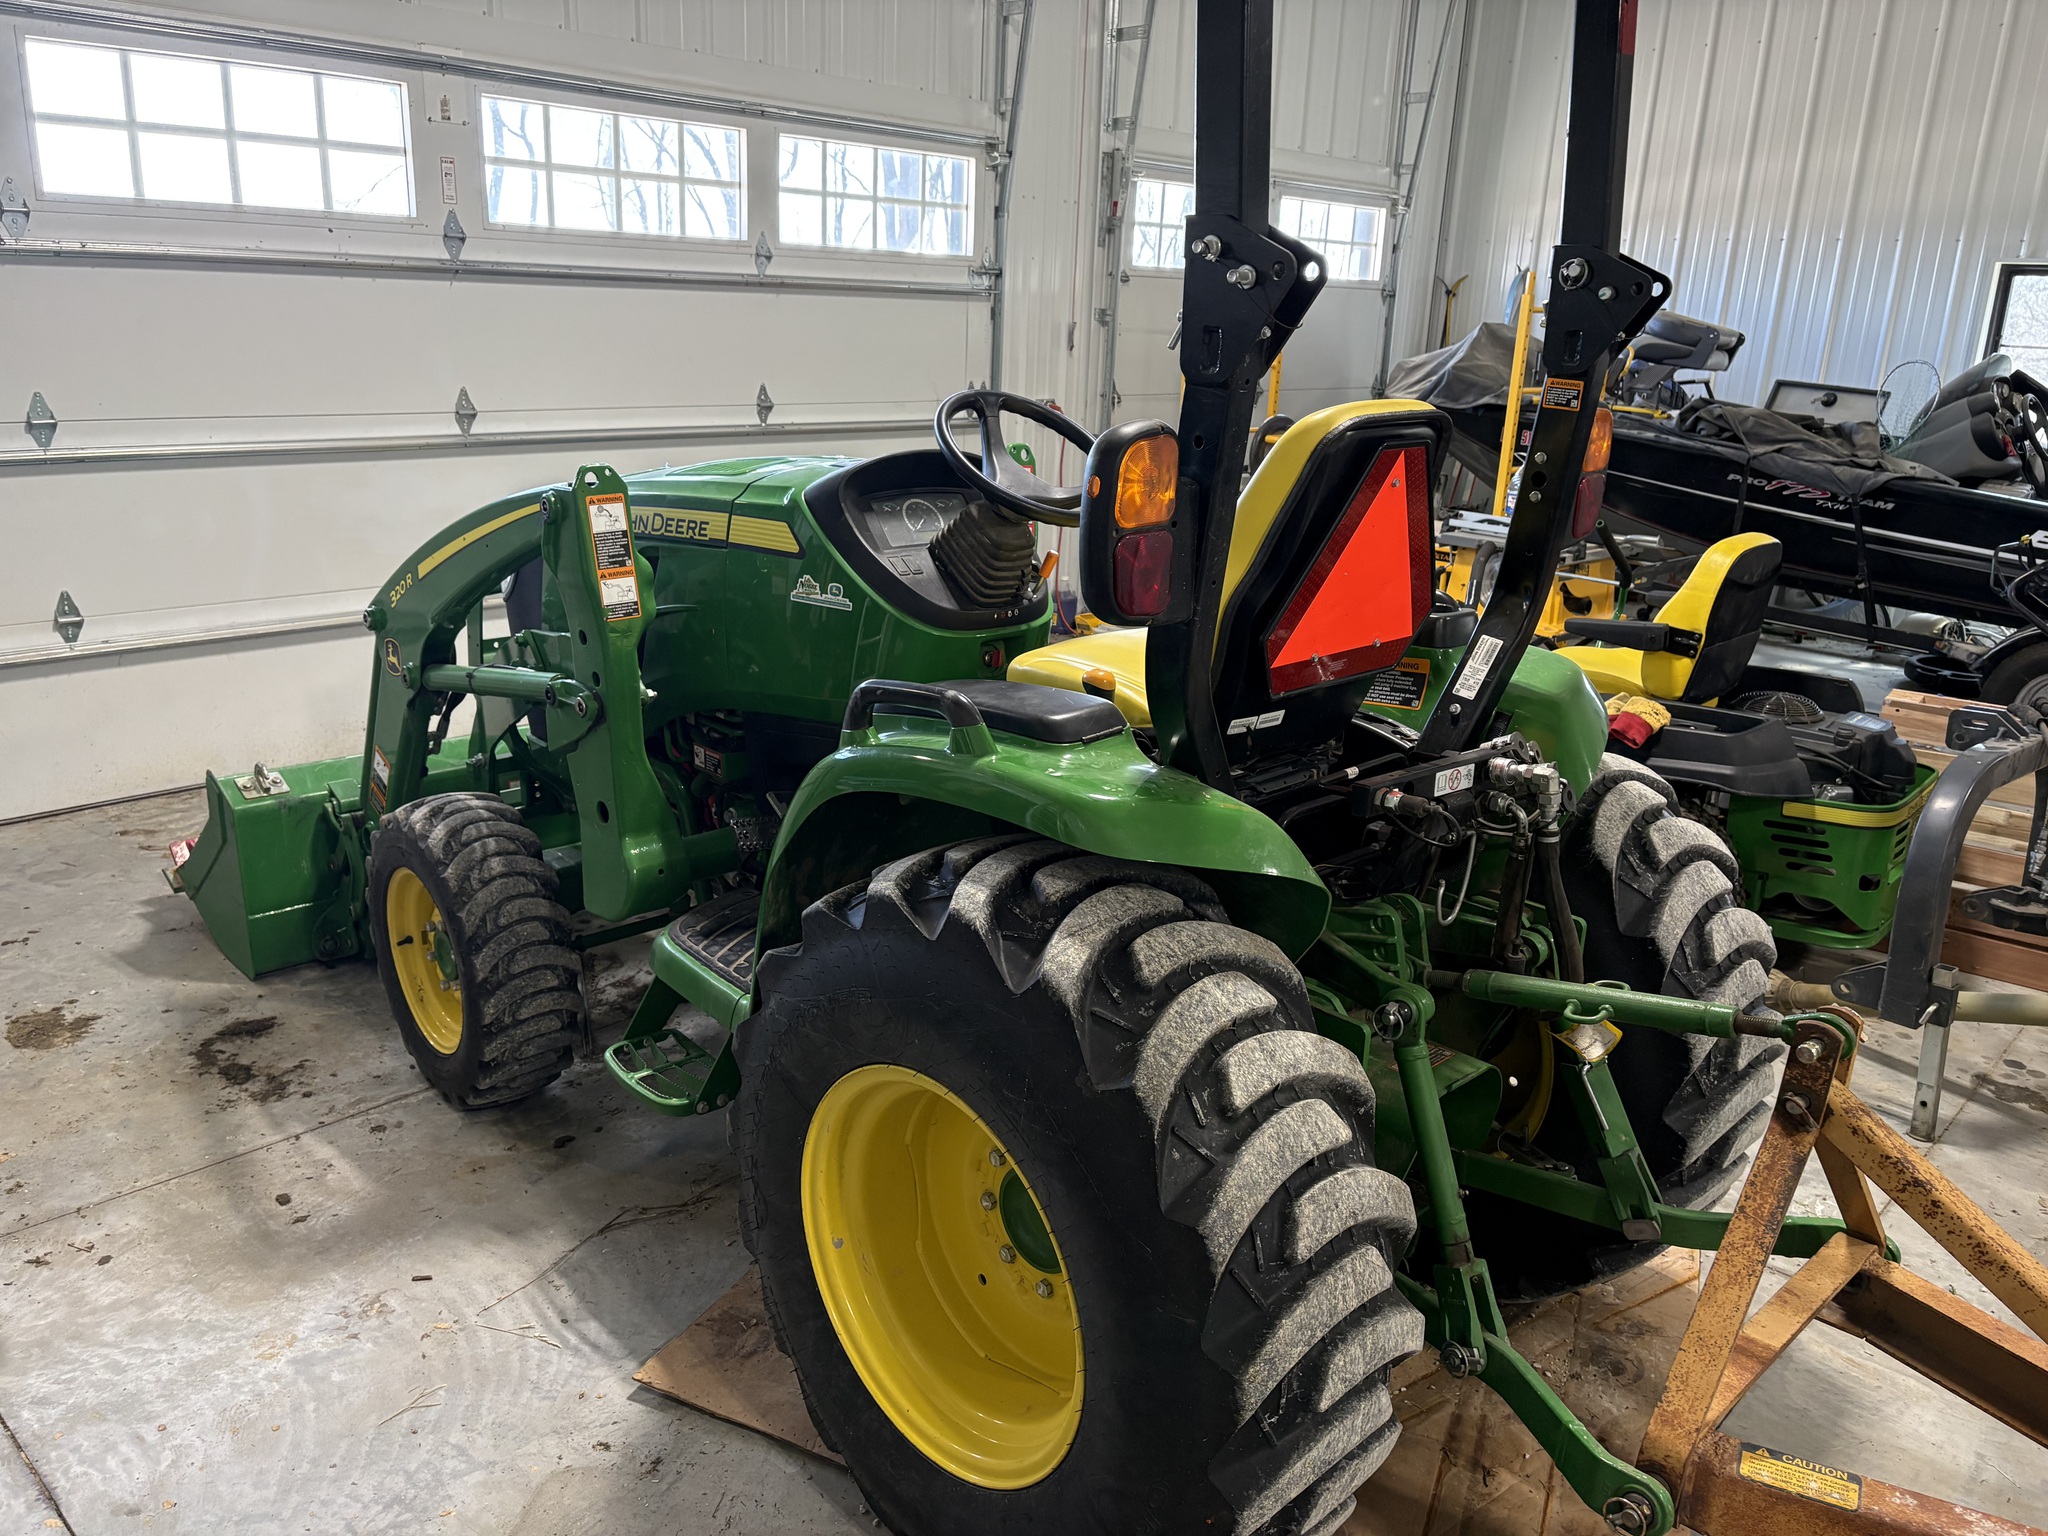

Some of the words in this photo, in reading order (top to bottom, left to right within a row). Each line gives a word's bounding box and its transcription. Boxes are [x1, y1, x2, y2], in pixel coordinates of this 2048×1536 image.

[1837, 495, 1896, 512] TAM
[632, 514, 649, 532] HN
[651, 512, 710, 538] DEERE
[607, 569, 634, 577] WARNING
[390, 580, 406, 608] 320
[1782, 1454, 1848, 1480] CAUTION
